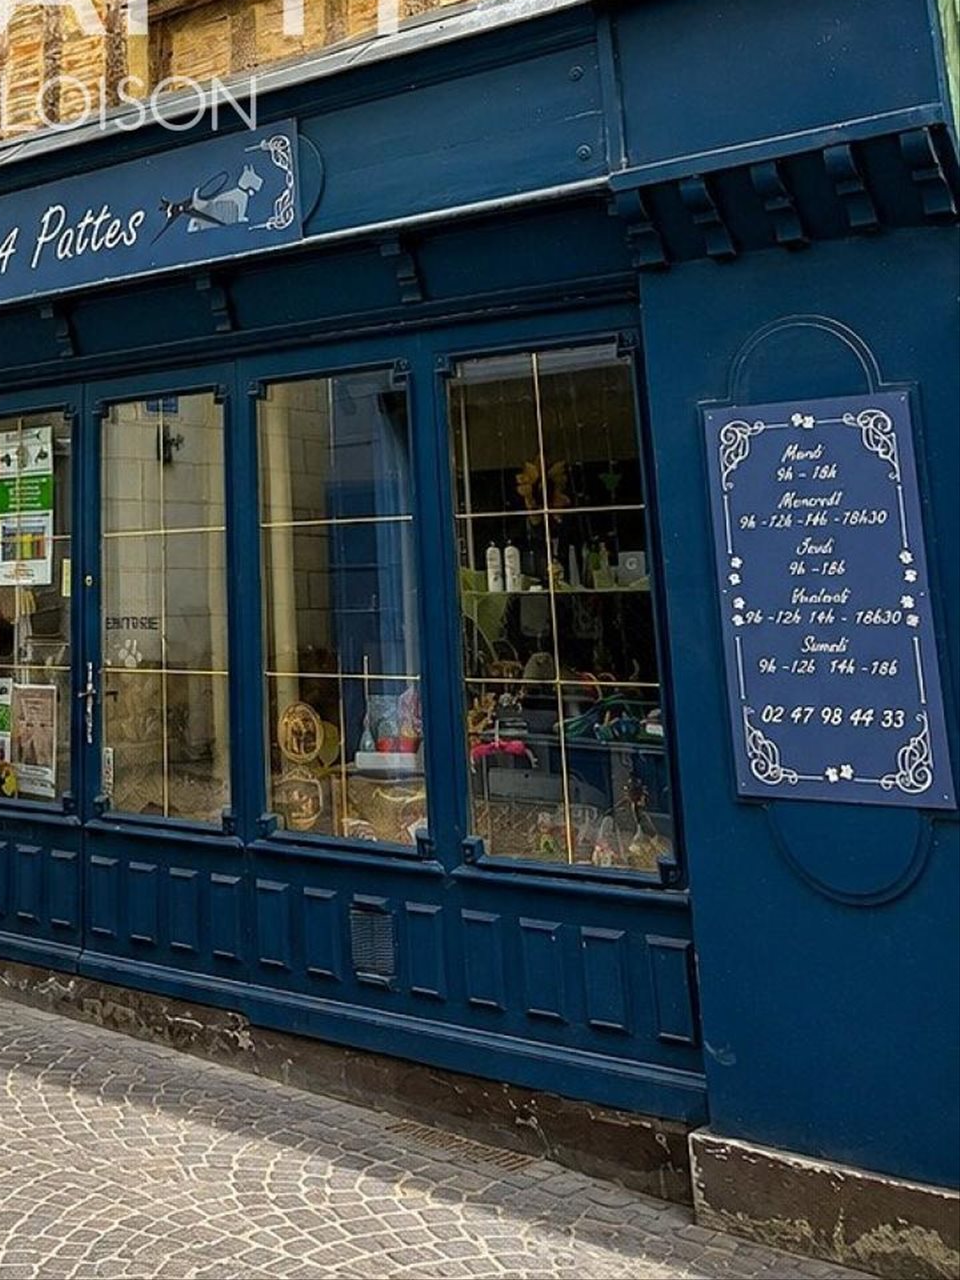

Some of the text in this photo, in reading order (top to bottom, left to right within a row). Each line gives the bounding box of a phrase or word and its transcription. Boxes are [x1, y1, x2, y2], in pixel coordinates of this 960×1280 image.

[30, 204, 146, 269] Pattes
[761, 705, 905, 728] 02 47 98 44 33
